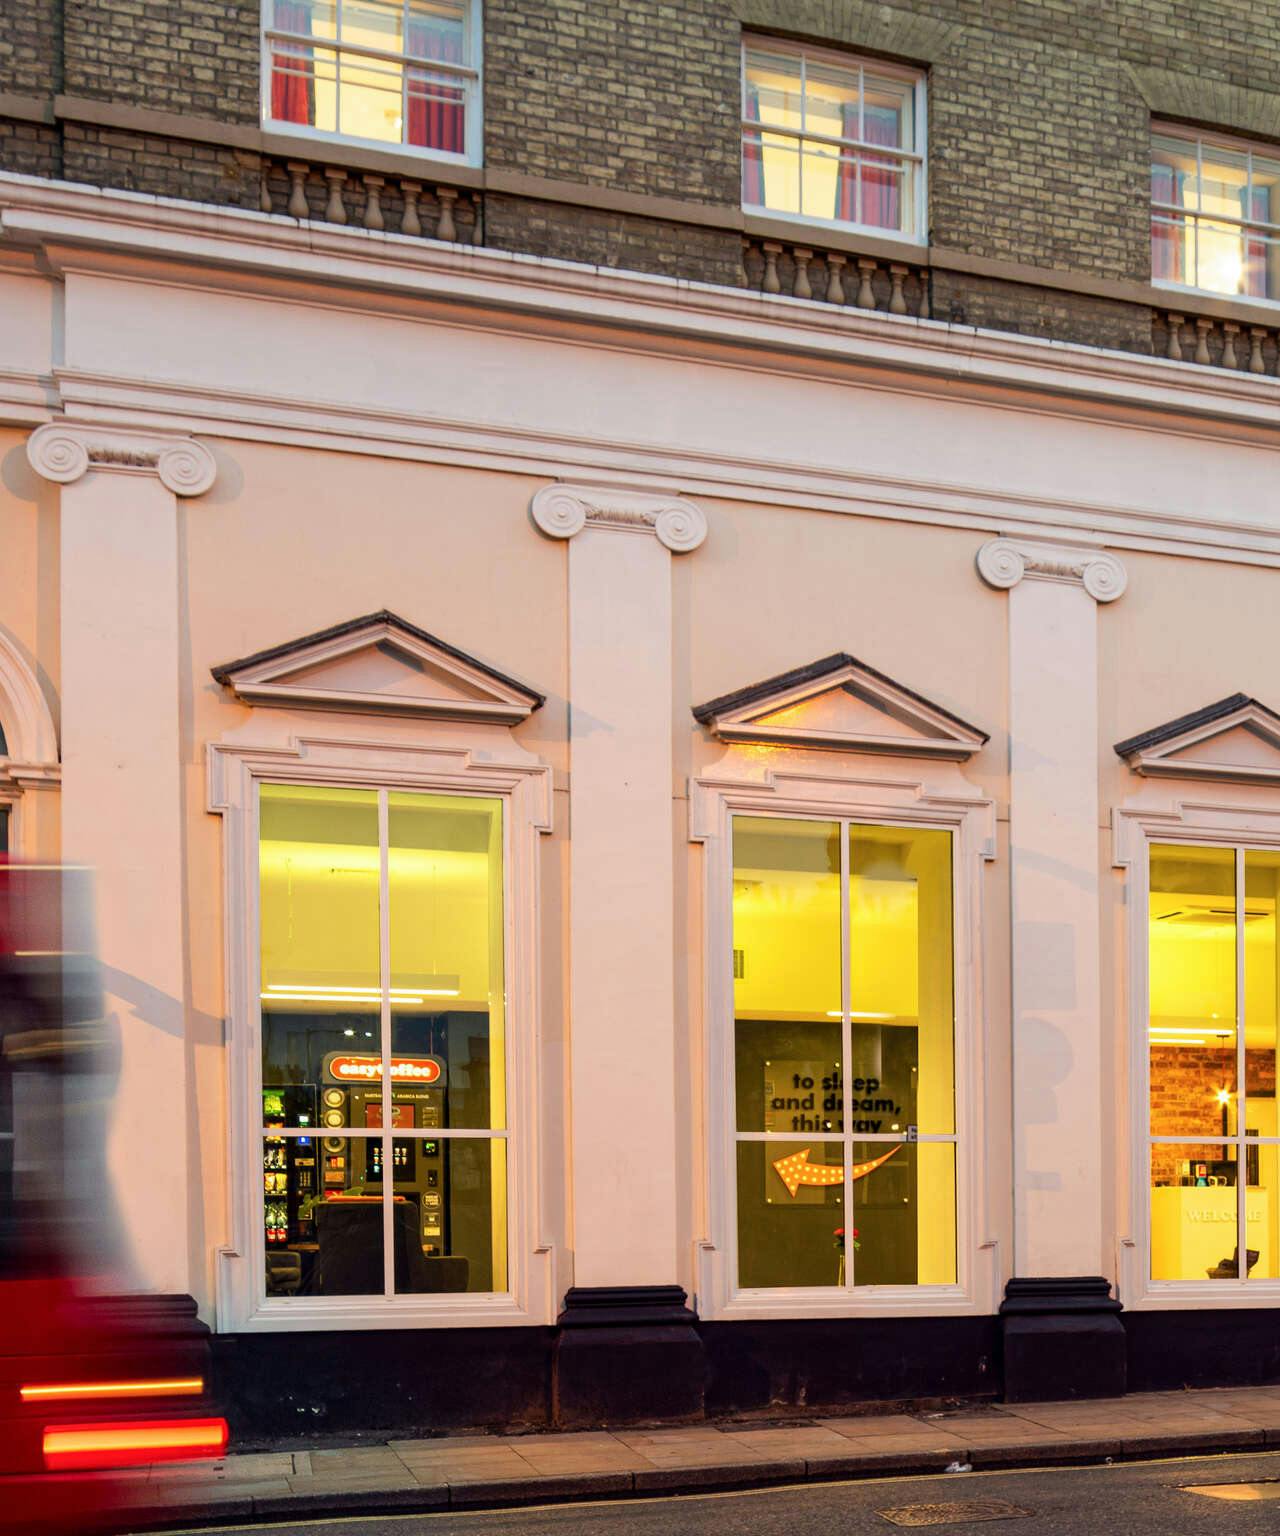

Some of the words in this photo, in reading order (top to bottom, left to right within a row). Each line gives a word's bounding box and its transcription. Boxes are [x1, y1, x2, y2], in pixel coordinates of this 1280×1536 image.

[793, 1073, 814, 1090] to
[771, 1093, 815, 1110] and
[823, 1093, 901, 1115] dream,
[792, 1114, 832, 1133] this
